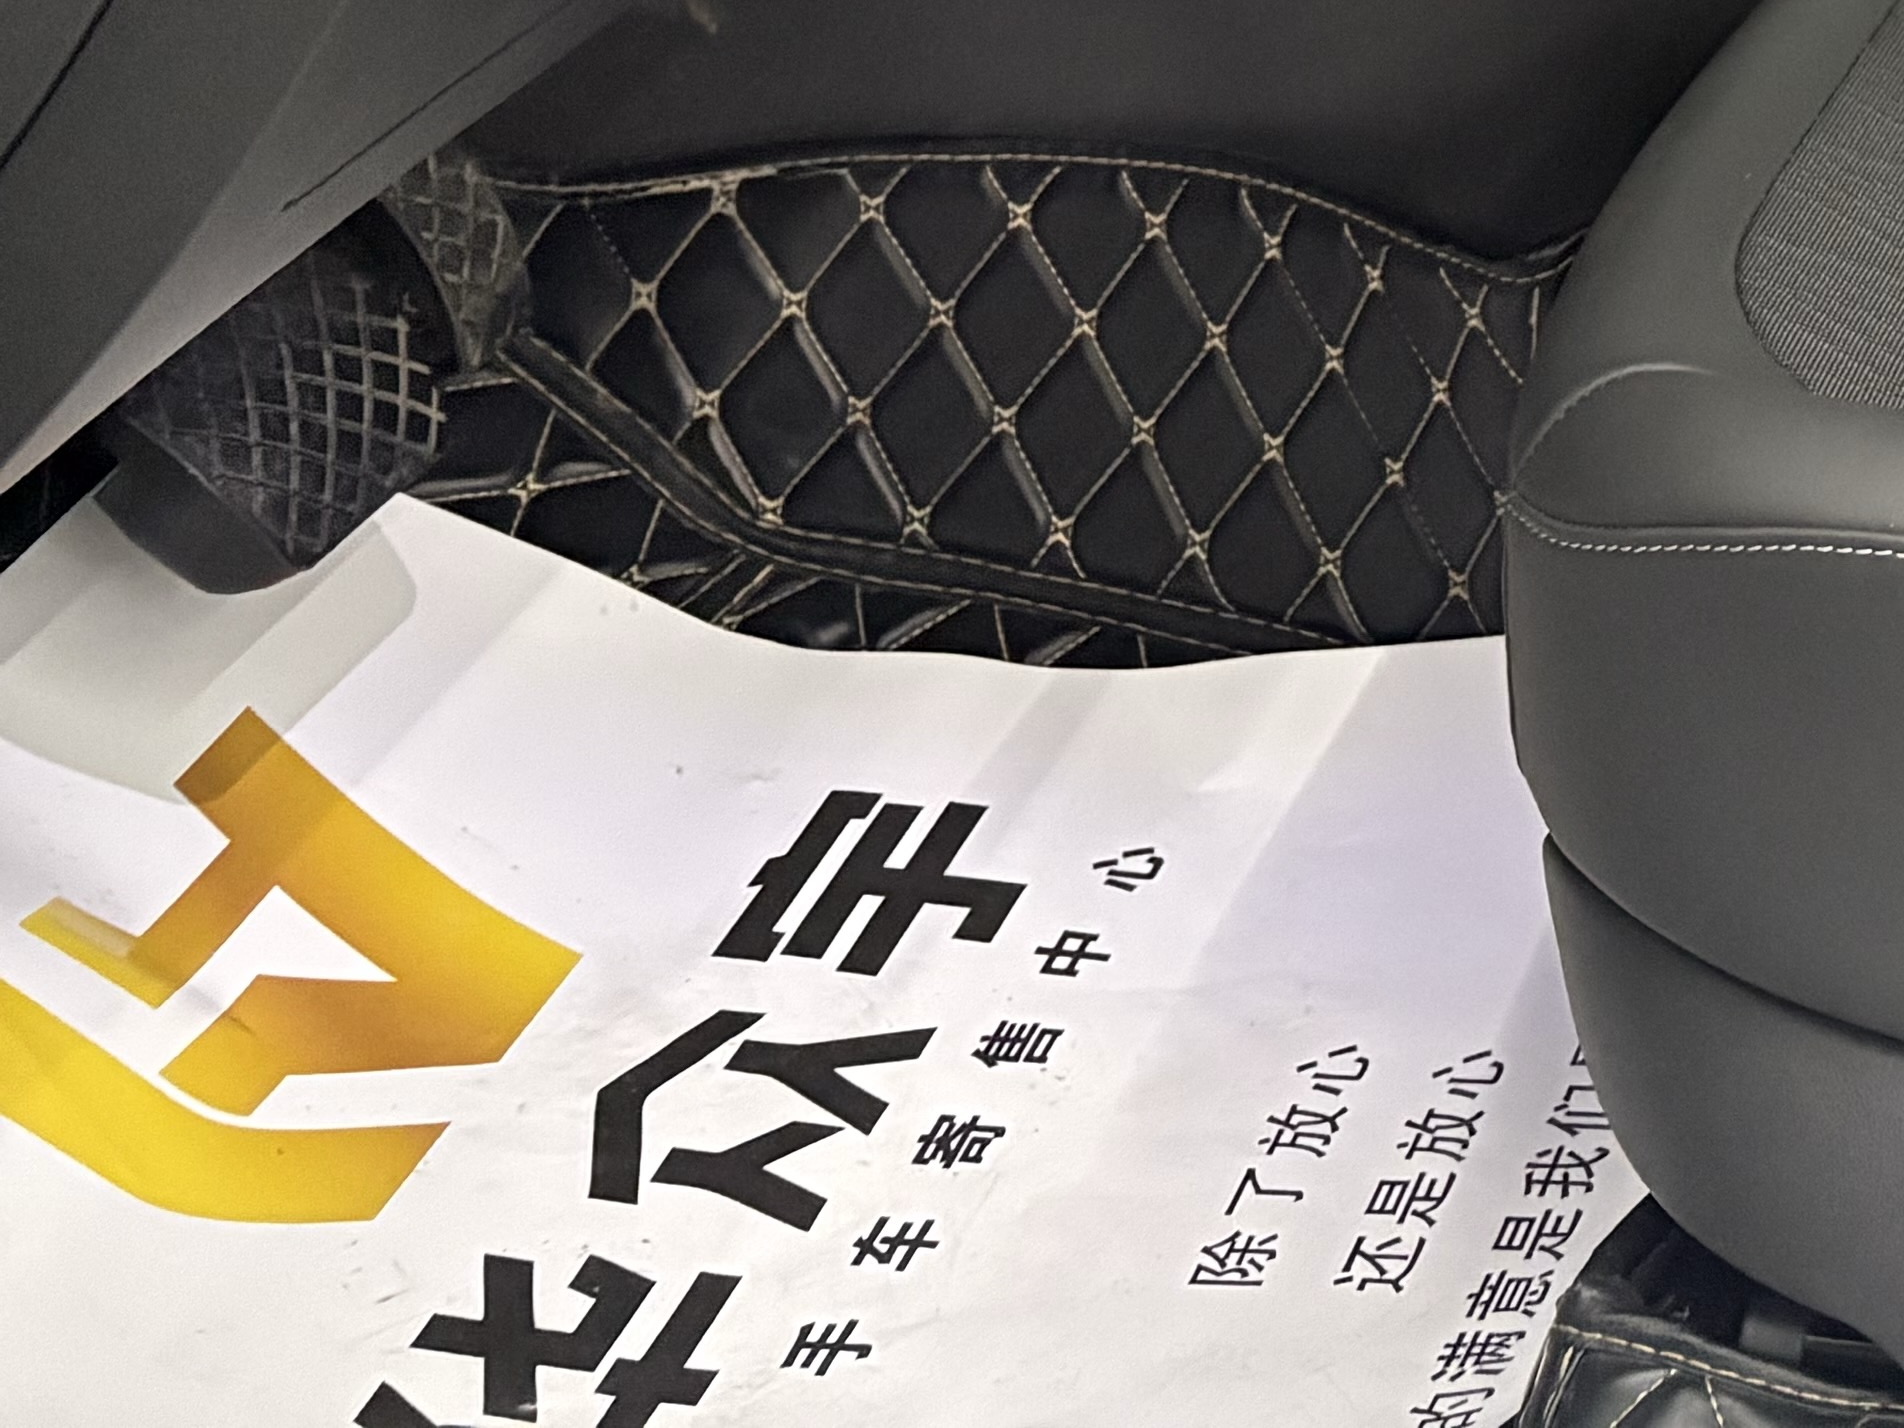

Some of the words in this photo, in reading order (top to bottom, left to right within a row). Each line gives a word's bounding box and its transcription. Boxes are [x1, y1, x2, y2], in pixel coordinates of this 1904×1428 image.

[780, 847, 1166, 1377] 手车寄售中心
[1188, 1045, 1370, 1287] 除了放心
[1333, 1049, 1505, 1293] 还是放心
[1410, 1044, 1614, 1428] 的满意是我们
